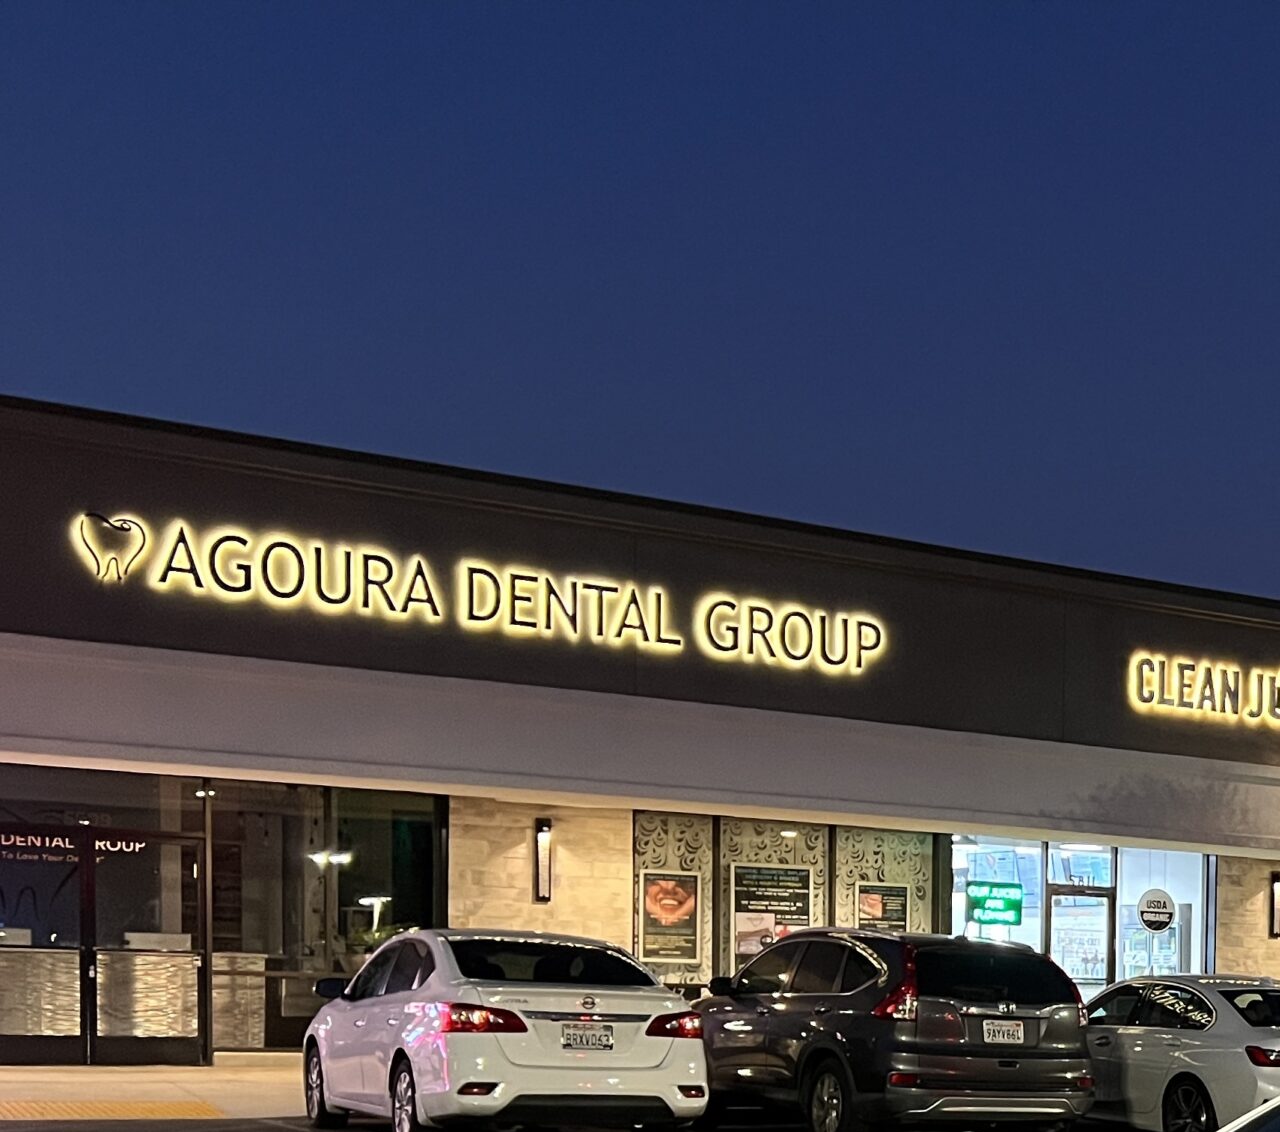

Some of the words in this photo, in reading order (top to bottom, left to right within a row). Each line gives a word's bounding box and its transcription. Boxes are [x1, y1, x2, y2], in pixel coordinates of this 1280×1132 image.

[156, 525, 442, 618] AGOURA
[466, 565, 682, 647] DENTAL
[704, 599, 882, 670] GROUP
[1134, 656, 1241, 715] CLEAN
[94, 840, 146, 852] ROUP
[1146, 900, 1167, 910] USDA
